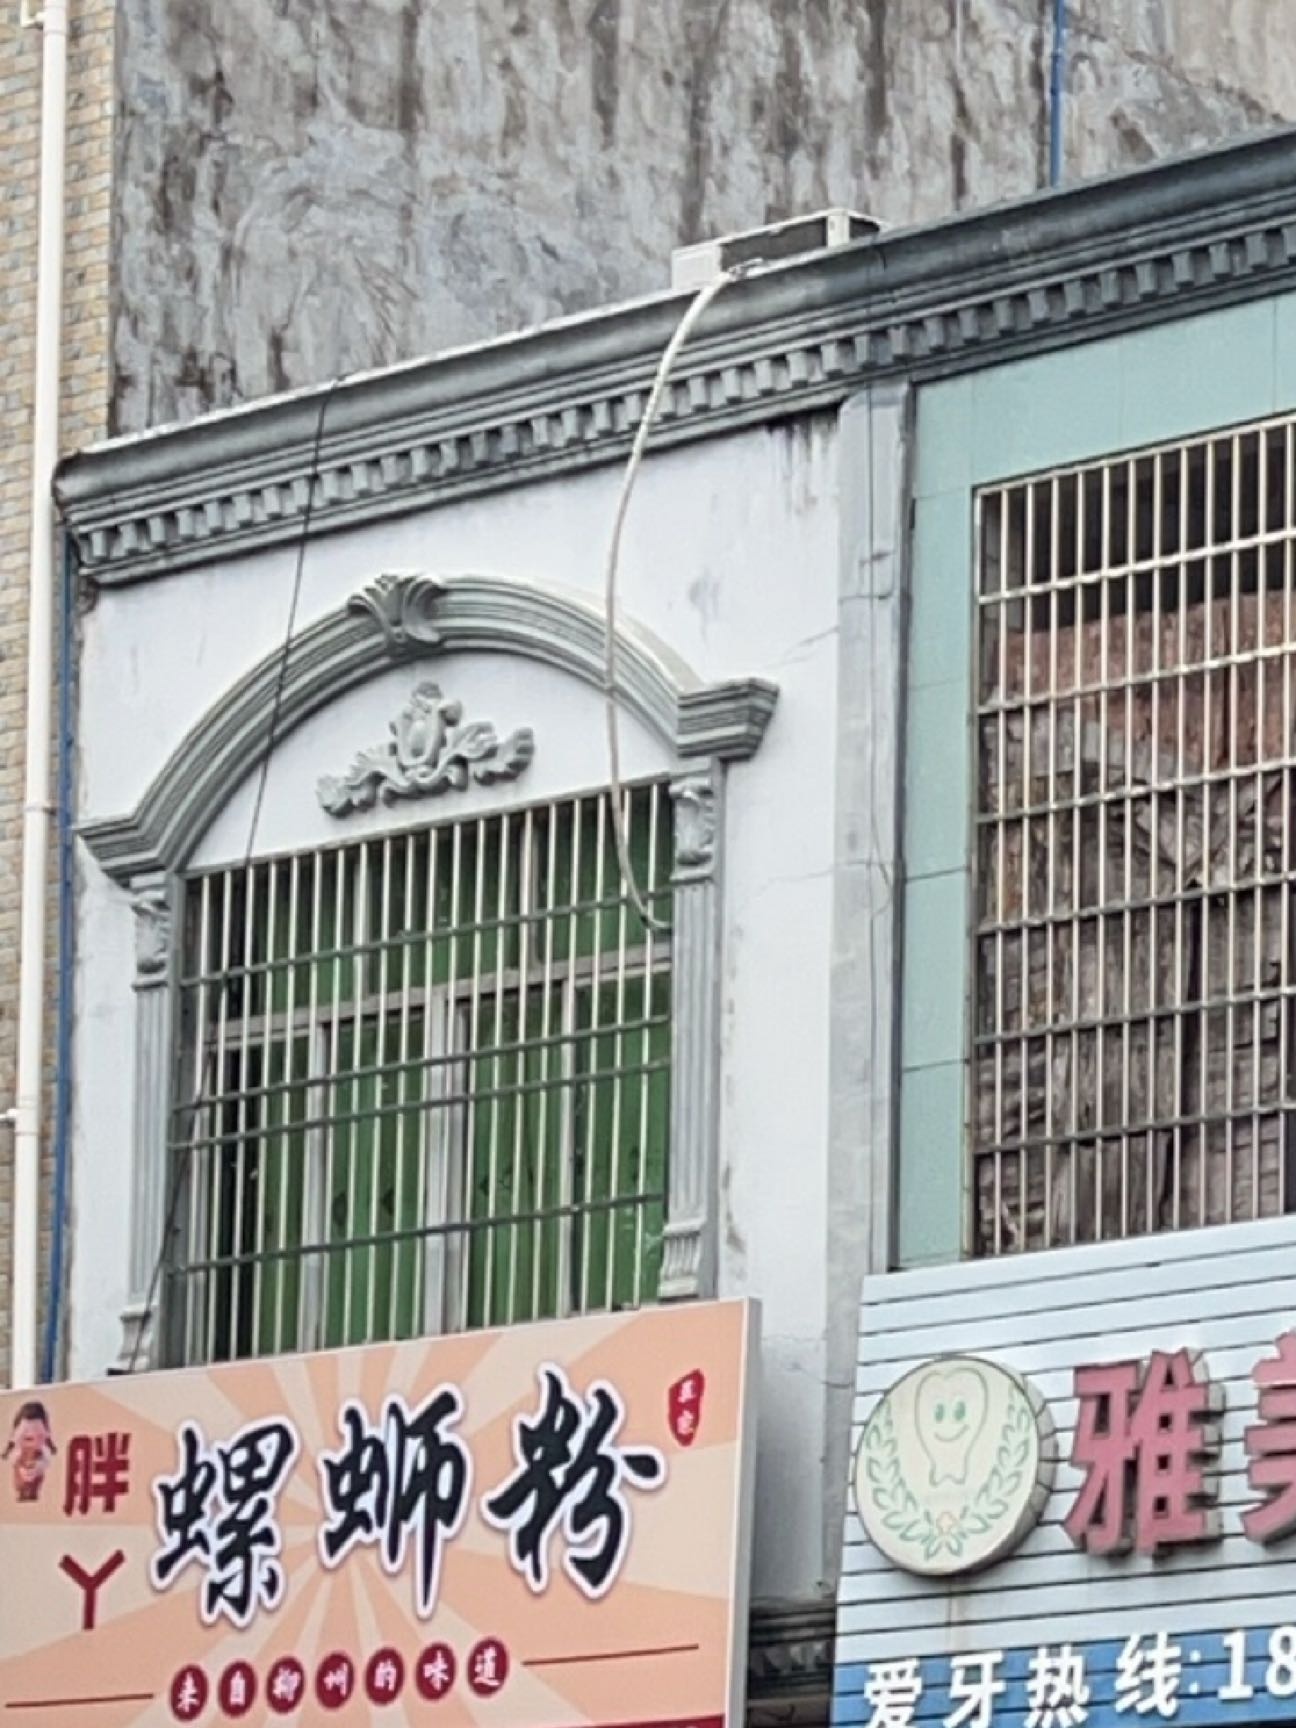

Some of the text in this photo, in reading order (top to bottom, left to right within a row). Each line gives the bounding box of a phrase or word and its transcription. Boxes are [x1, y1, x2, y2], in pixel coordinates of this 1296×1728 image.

[59, 1431, 131, 1630] 胖丫
[154, 1366, 664, 1616] 螺蛳粉
[172, 1640, 507, 1717] 来自柳州的味道
